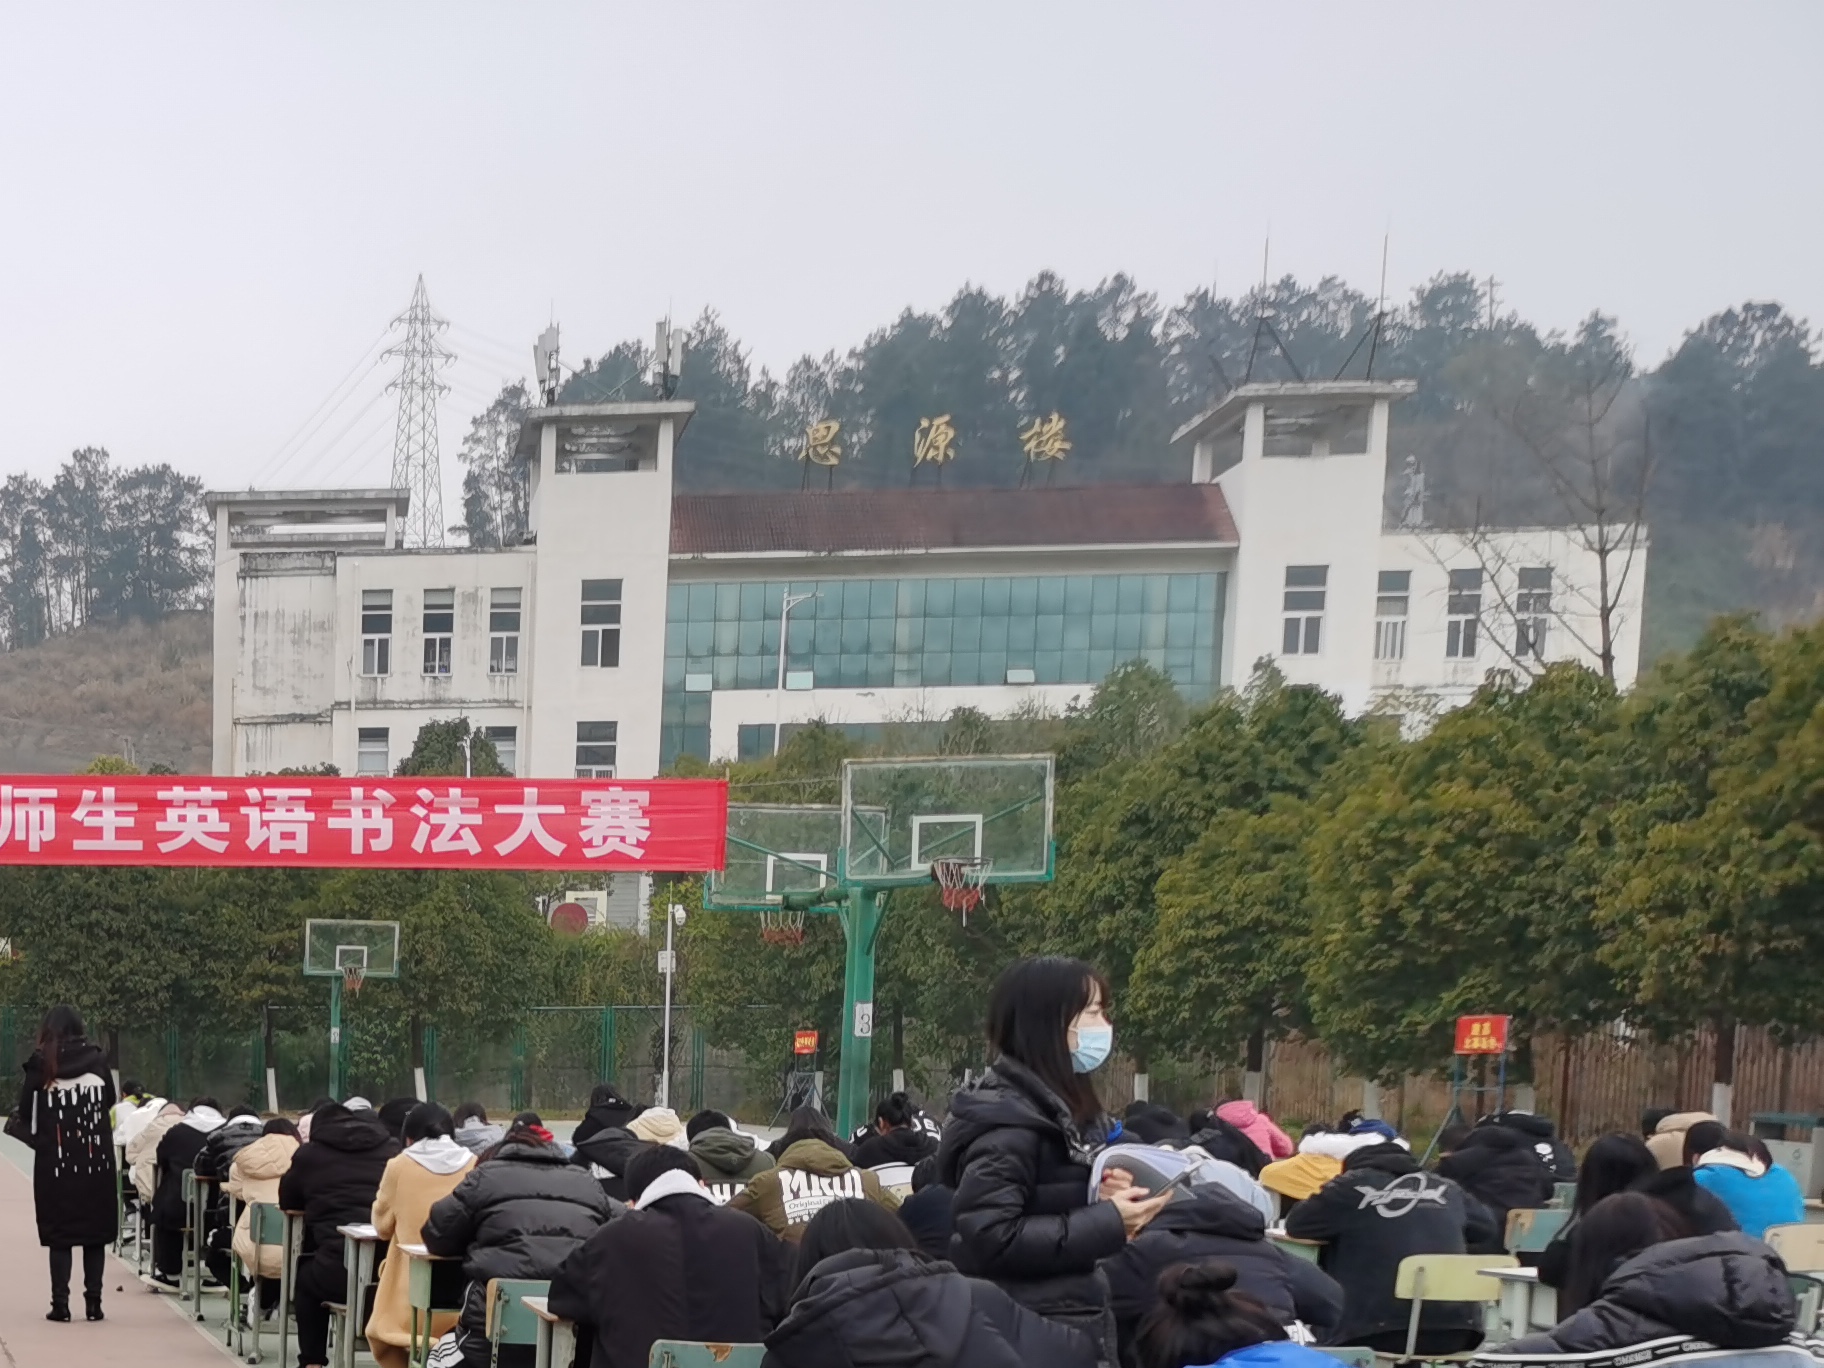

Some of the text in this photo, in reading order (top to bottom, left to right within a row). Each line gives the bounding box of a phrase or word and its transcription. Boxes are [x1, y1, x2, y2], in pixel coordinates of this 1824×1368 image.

[798, 410, 1072, 468] 思源楼
[860, 1013, 871, 1034] 3
